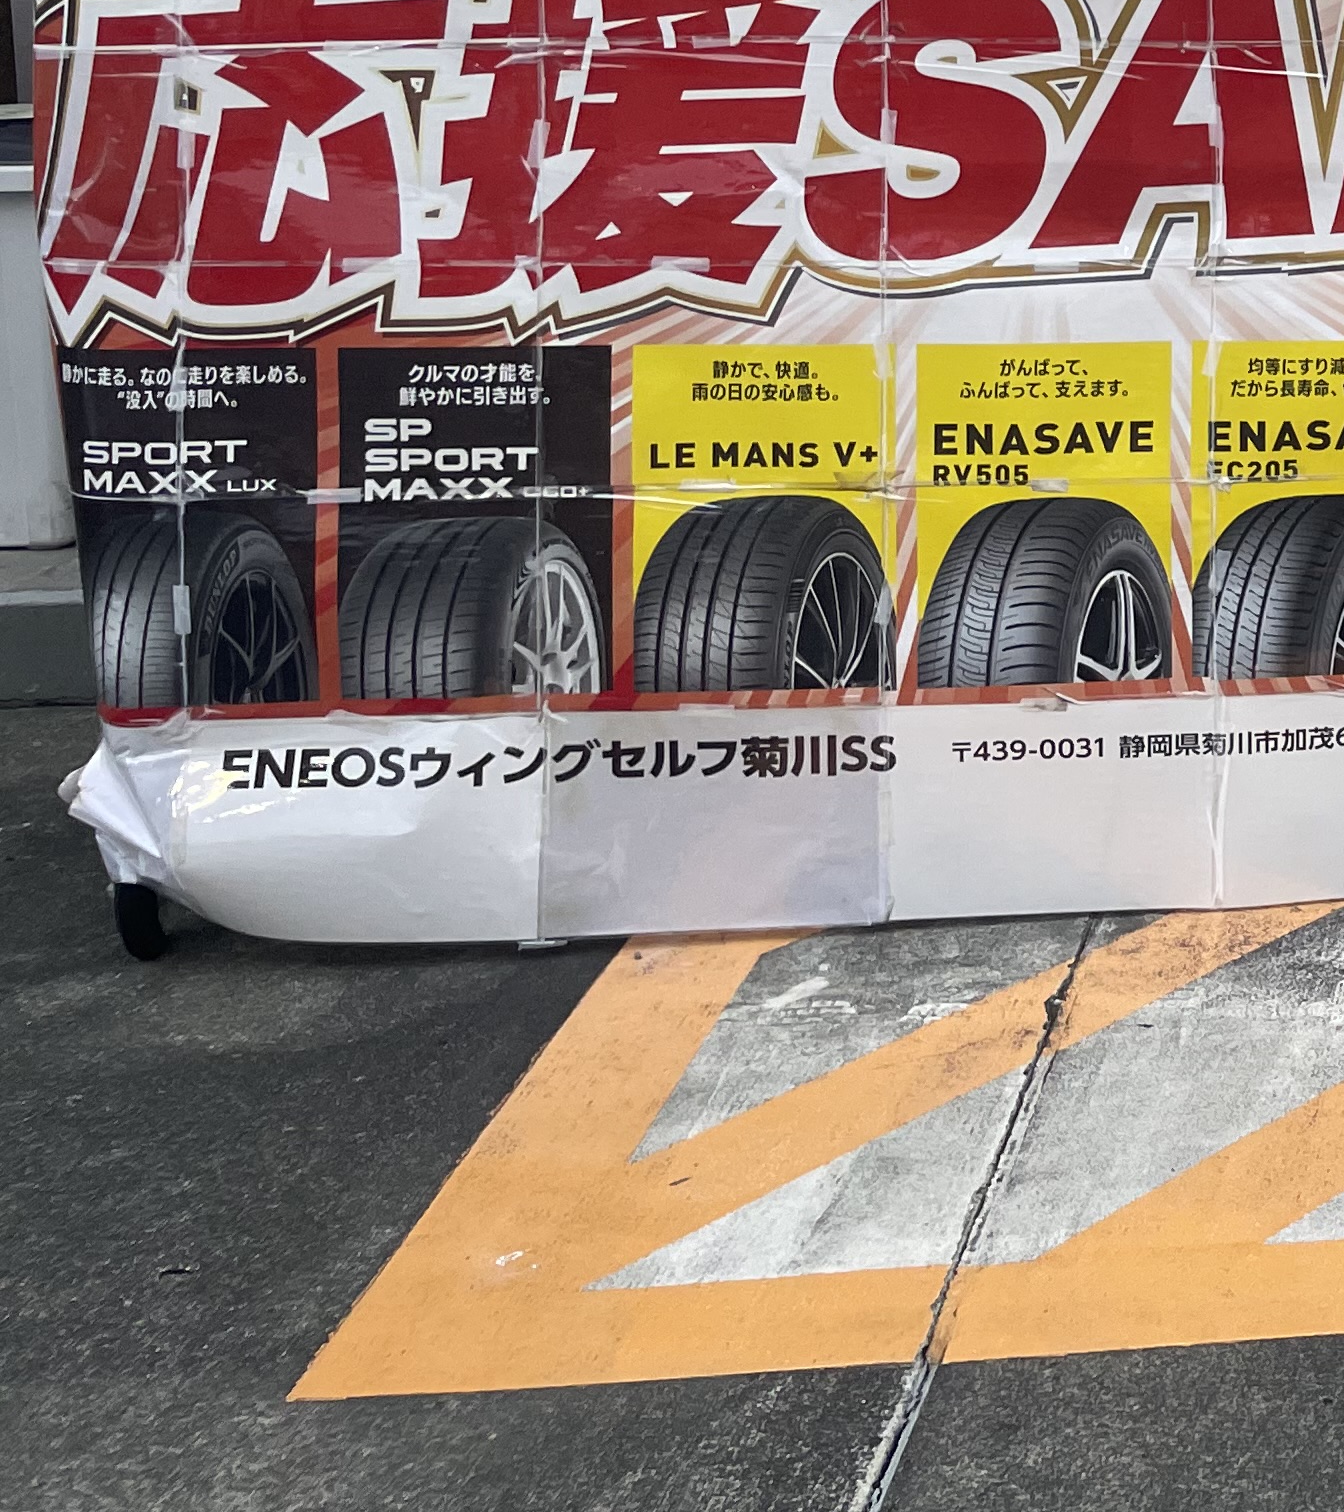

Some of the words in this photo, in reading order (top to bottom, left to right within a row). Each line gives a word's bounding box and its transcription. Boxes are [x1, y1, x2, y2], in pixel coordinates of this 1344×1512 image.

[712, 360, 820, 380] 静かで、快適。
[999, 359, 1090, 378] がんばって、
[399, 385, 551, 407] 鮮やかに引き出す。
[691, 382, 841, 403] 雨の日の安心感も。
[959, 380, 1130, 399] ふんばって、支えます。
[364, 418, 432, 442] SP
[933, 420, 1155, 456] ENASAVE
[83, 440, 248, 465] SPORT
[364, 446, 539, 472] SPORT
[649, 442, 697, 469] LE
[711, 441, 820, 469] MANS
[835, 441, 879, 466] V+
[83, 469, 218, 494] MAXX
[227, 478, 277, 493] LUX
[933, 464, 1030, 486] RV505
[364, 477, 513, 502] MAXX
[223, 734, 897, 790] ENEOSウィングセルフ菊川SS
